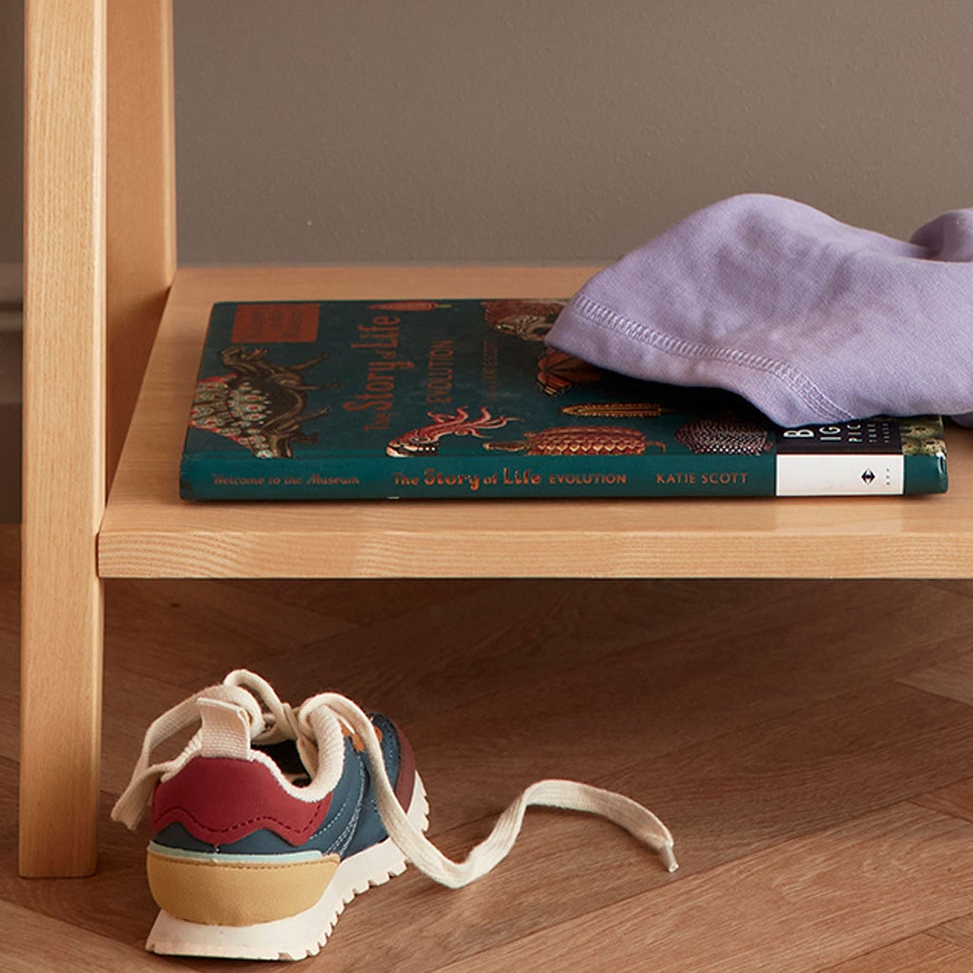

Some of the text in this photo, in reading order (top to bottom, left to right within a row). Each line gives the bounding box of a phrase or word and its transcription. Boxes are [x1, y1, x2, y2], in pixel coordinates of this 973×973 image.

[350, 316, 400, 348] Life
[426, 339, 454, 403] EVOLUTION
[342, 362, 415, 411] Story
[783, 429, 814, 438] B
[819, 426, 842, 441] IG
[212, 474, 264, 485] Welcome
[268, 475, 281, 485] to
[306, 473, 359, 485] Museum
[394, 468, 626, 491] The Story of Life EVOLUTION
[656, 473, 748, 484] KATIE SCOTT
